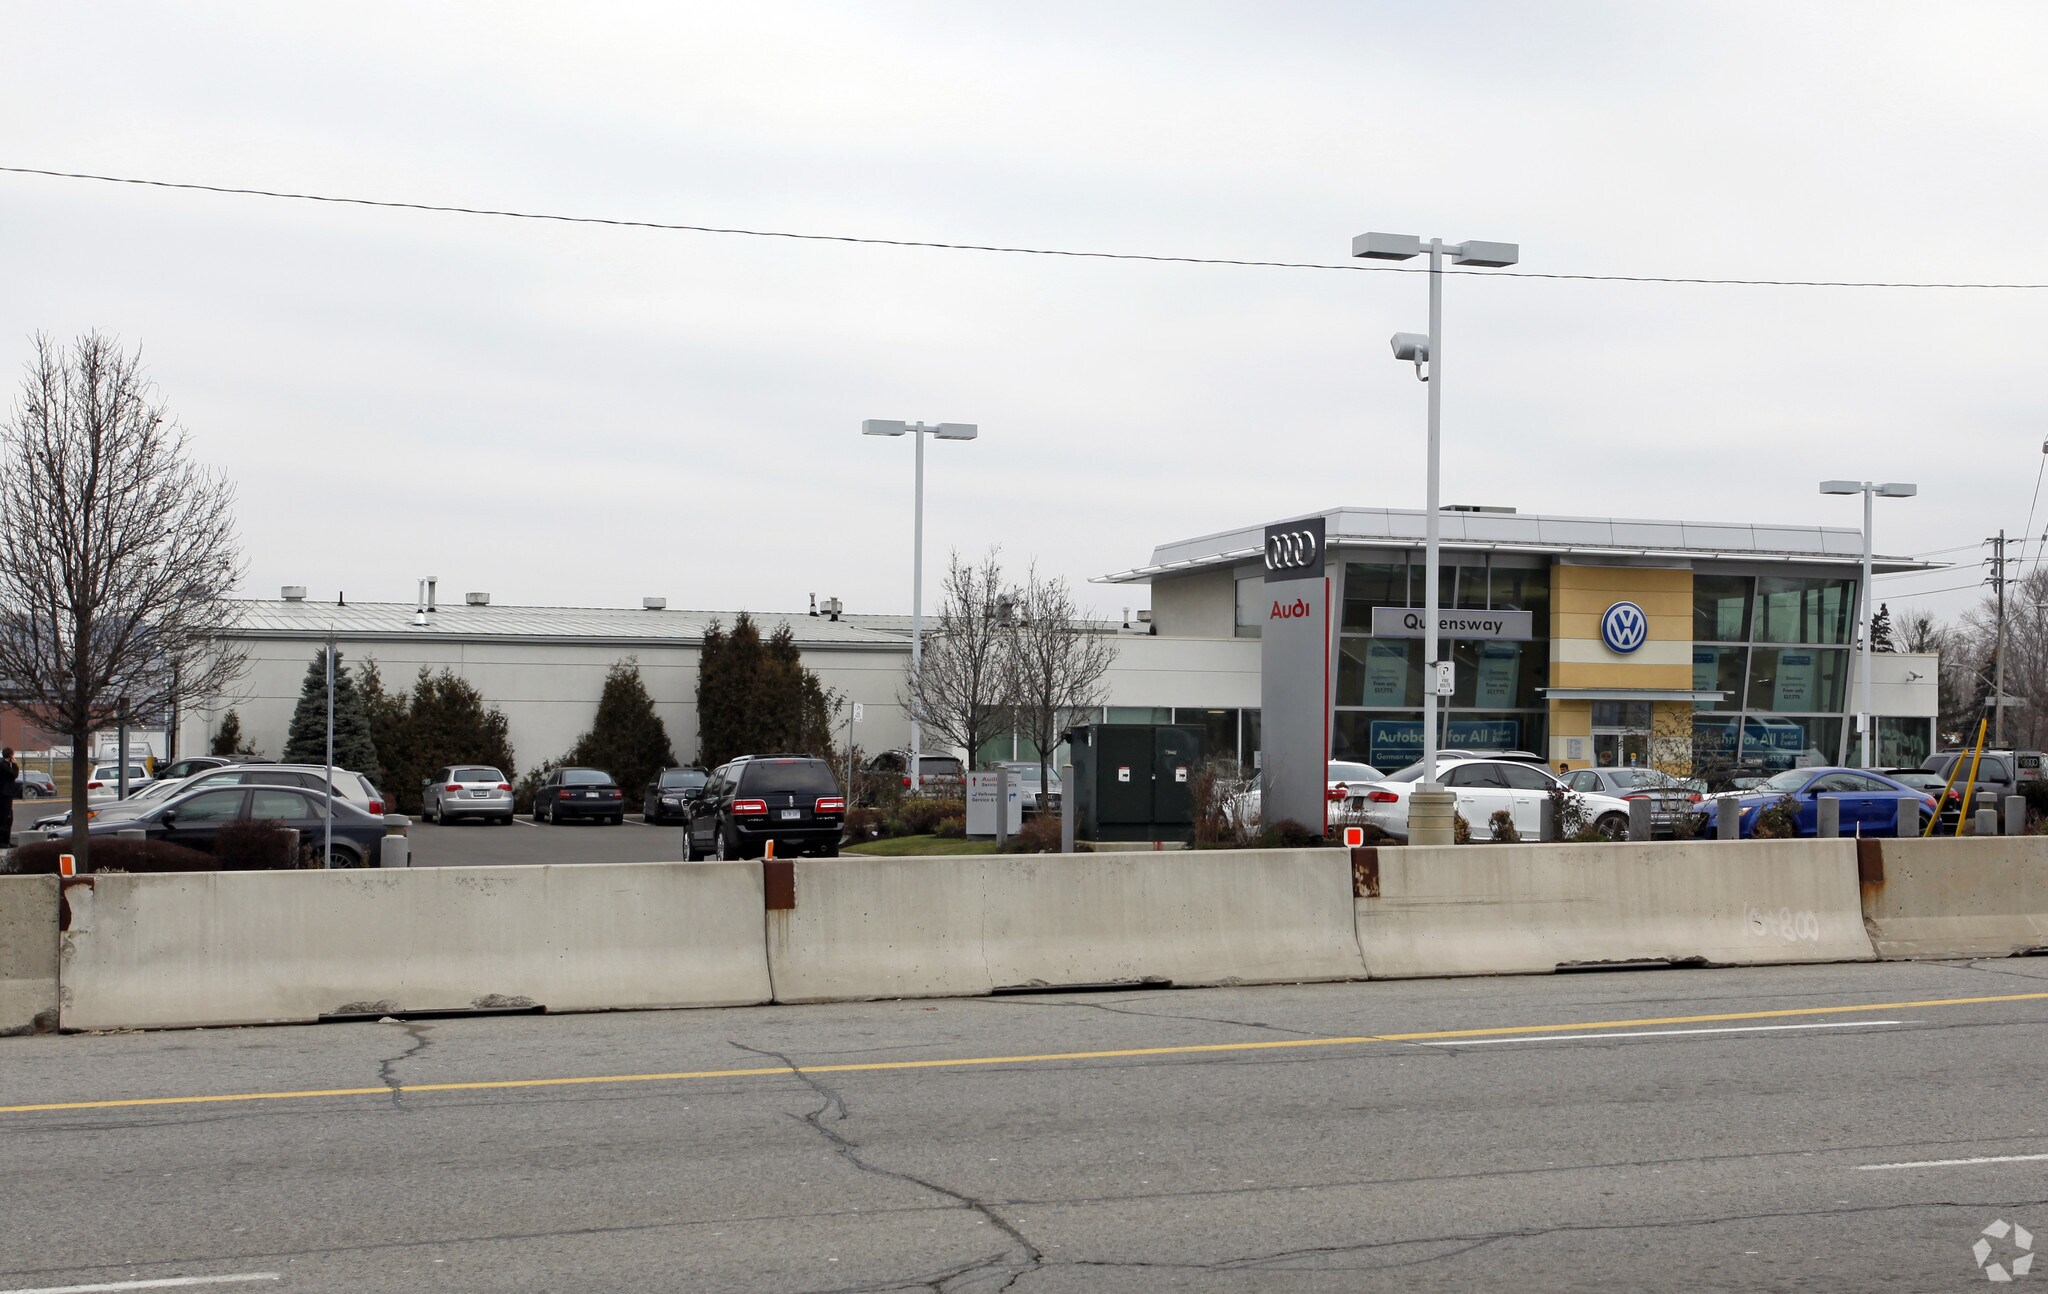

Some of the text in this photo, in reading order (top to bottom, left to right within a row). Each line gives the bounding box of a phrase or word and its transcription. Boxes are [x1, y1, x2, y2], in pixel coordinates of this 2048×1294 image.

[1270, 598, 1310, 620] Audi
[1403, 613, 1503, 635] Quensway
[1377, 729, 1488, 743] Autoban for All
[1760, 733, 1777, 746] All
[1781, 732, 1798, 740] Sales
[1376, 752, 1404, 760] German
